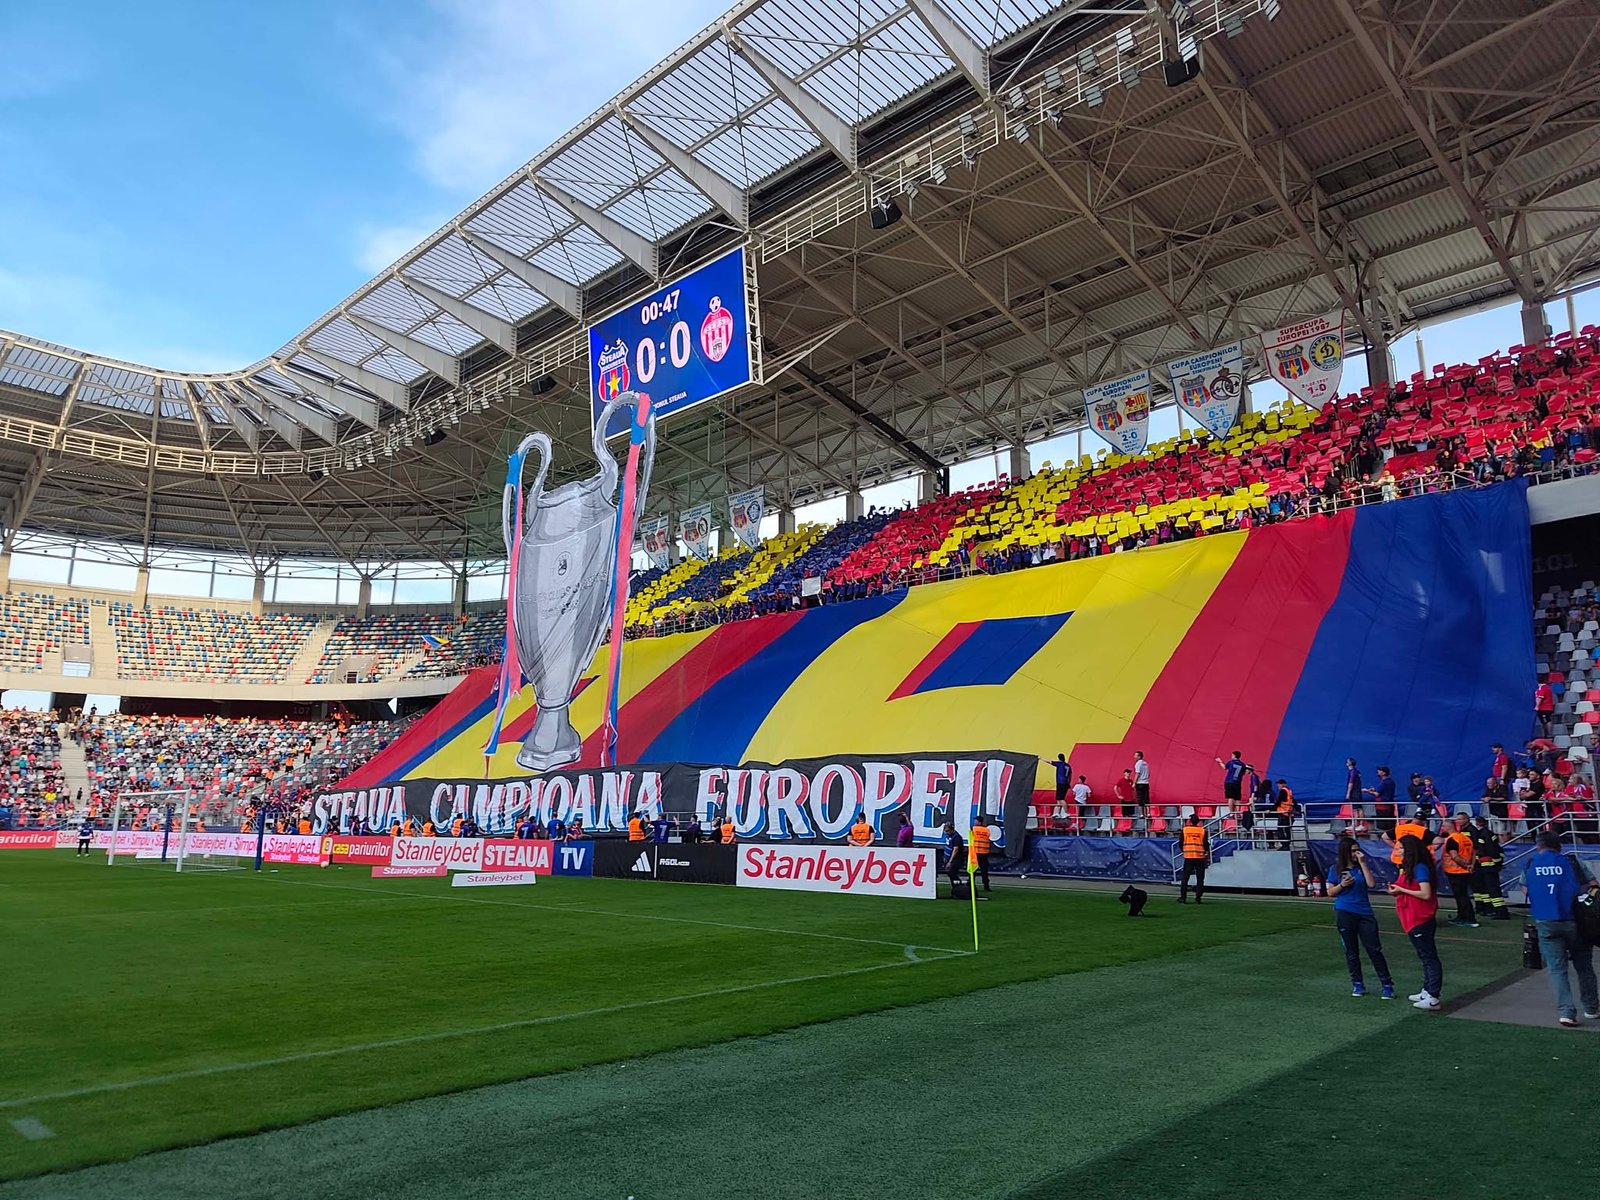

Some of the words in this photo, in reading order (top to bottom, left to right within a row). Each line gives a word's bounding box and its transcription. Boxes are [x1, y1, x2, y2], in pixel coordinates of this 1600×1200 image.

[641, 289, 680, 324] 00:47
[1276, 330, 1310, 343] EUROPEI
[1310, 321, 1330, 334] 1987
[1279, 317, 1325, 336] SUPERCUPA
[600, 345, 626, 366] STEAUA
[636, 321, 691, 384] 0:0
[1171, 360, 1190, 370] CUPA
[1191, 345, 1238, 365] CAMPIONILOR
[1189, 357, 1223, 371] EUROPENI
[1086, 387, 1103, 397] CUPA
[1103, 373, 1146, 391] CAMPIONILOR
[1102, 384, 1132, 397] EUROPENI
[1307, 383, 1327, 395] 1-0
[668, 391, 687, 403] STEAUA
[1208, 408, 1226, 419] 0-1
[1121, 431, 1138, 441] 2-0
[292, 706, 311, 715] 107
[312, 785, 407, 836] STEAUA
[429, 770, 665, 837] CAMPIOANA
[0, 832, 54, 844] ariurilor
[520, 826, 529, 839] 7
[659, 824, 668, 840] 7
[234, 836, 259, 854] Simpl
[268, 837, 316, 855] Stanleybet
[395, 839, 480, 866] Stanleybet
[484, 844, 549, 868] STEAUA
[560, 847, 586, 870] TV
[382, 867, 437, 875] Stanleybet
[743, 847, 928, 890] Stanleybet
[1535, 866, 1563, 877] FOTO
[467, 873, 524, 883] Stanleybet
[1547, 883, 1556, 895] 7
